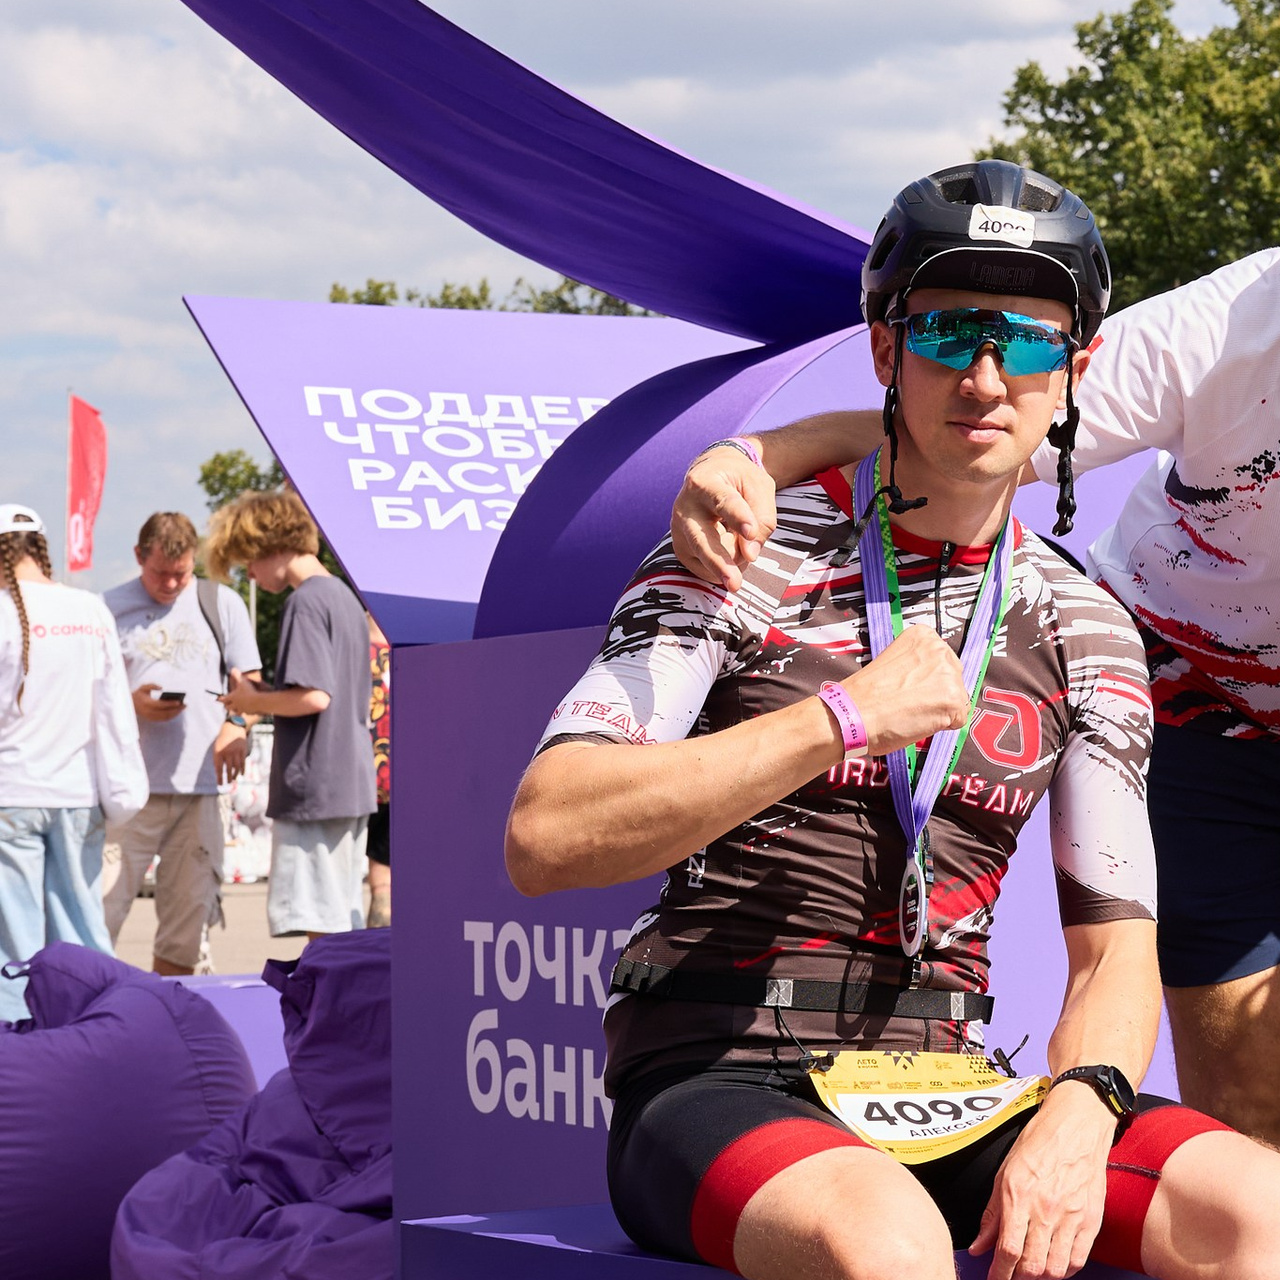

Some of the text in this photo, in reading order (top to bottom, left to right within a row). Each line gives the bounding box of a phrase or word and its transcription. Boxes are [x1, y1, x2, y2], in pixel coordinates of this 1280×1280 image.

[572, 700, 659, 746] TEAM
[826, 757, 1035, 817] IRO TEAM
[463, 920, 632, 1009] точк
[466, 1008, 614, 1131] банк
[863, 1096, 1003, 1126] 4090
[909, 1114, 990, 1138] АЛЕКСЕЙ
